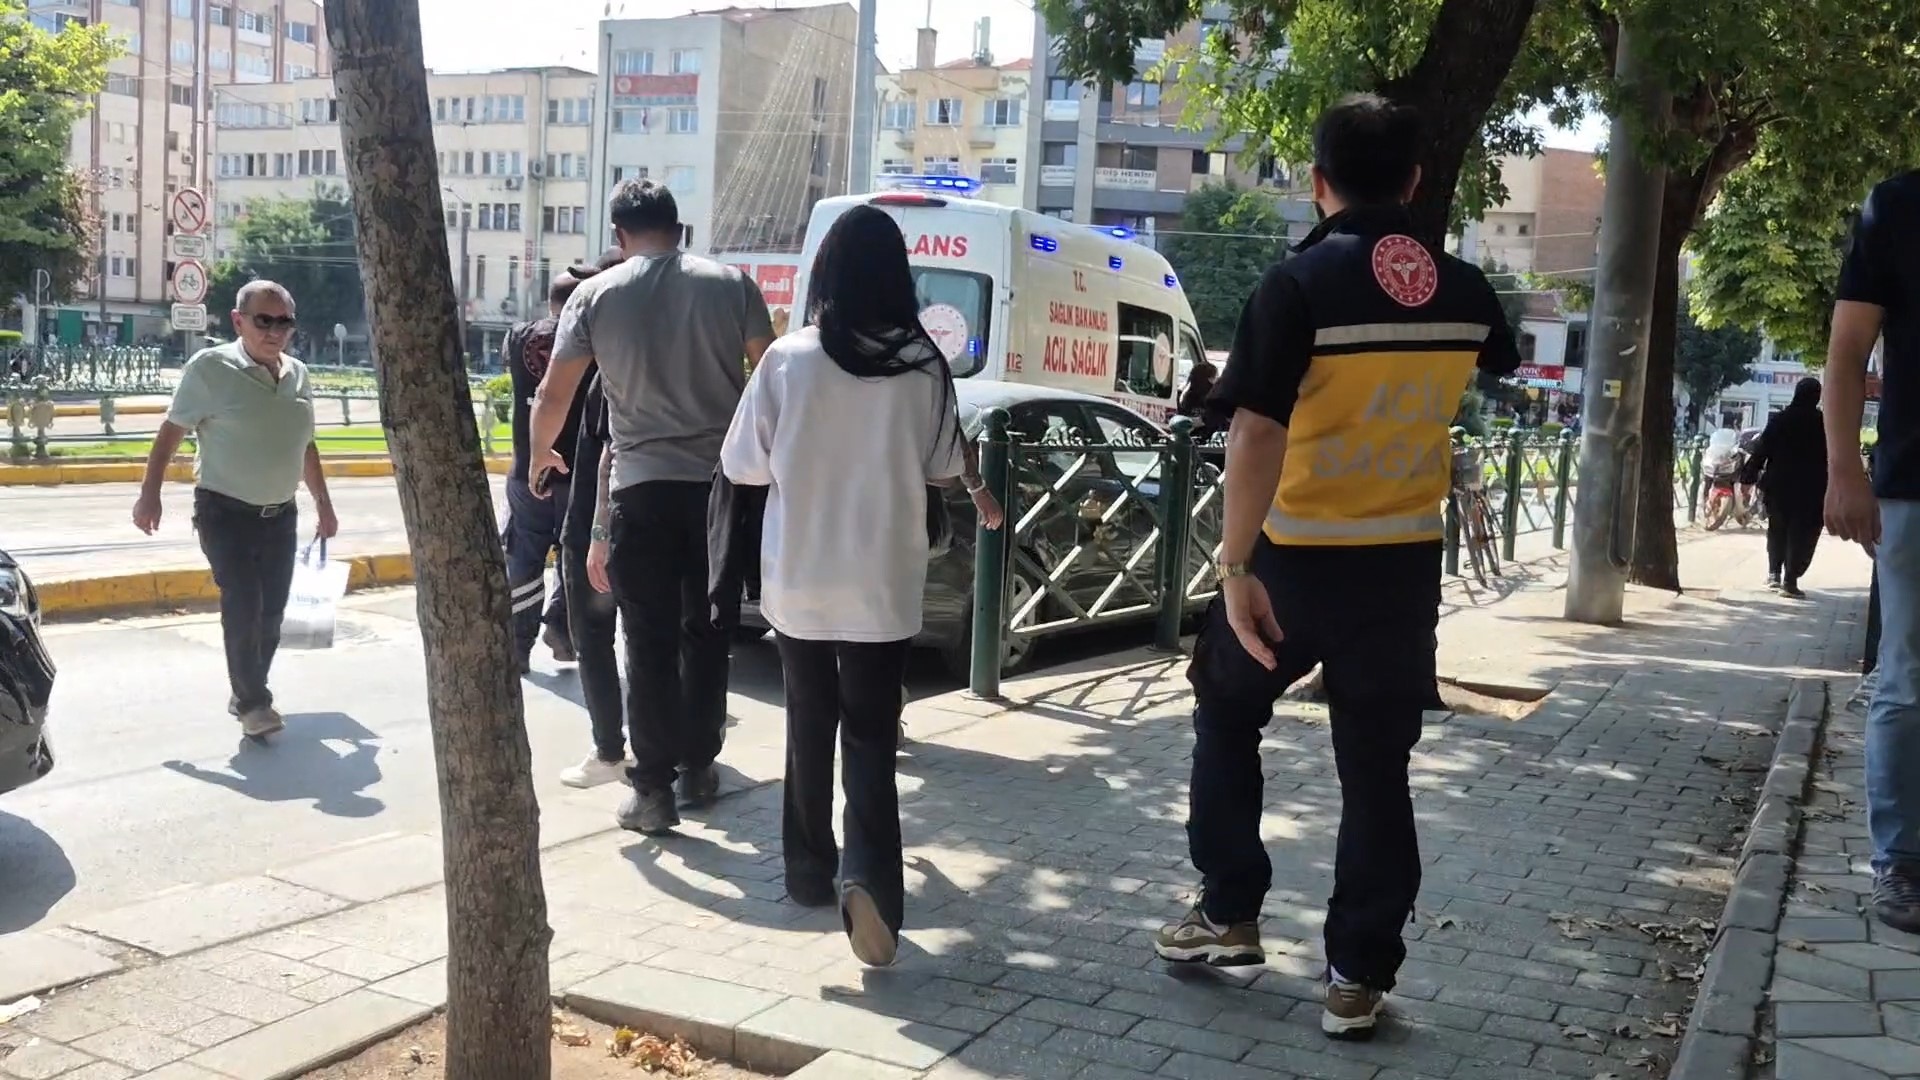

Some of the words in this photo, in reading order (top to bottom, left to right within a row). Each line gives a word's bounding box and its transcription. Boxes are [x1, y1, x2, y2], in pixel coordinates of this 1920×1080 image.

[1048, 300, 1074, 326] SAĞLIK
[1006, 351, 1022, 371] 112
[1070, 335, 1109, 377] SAĞLIK
